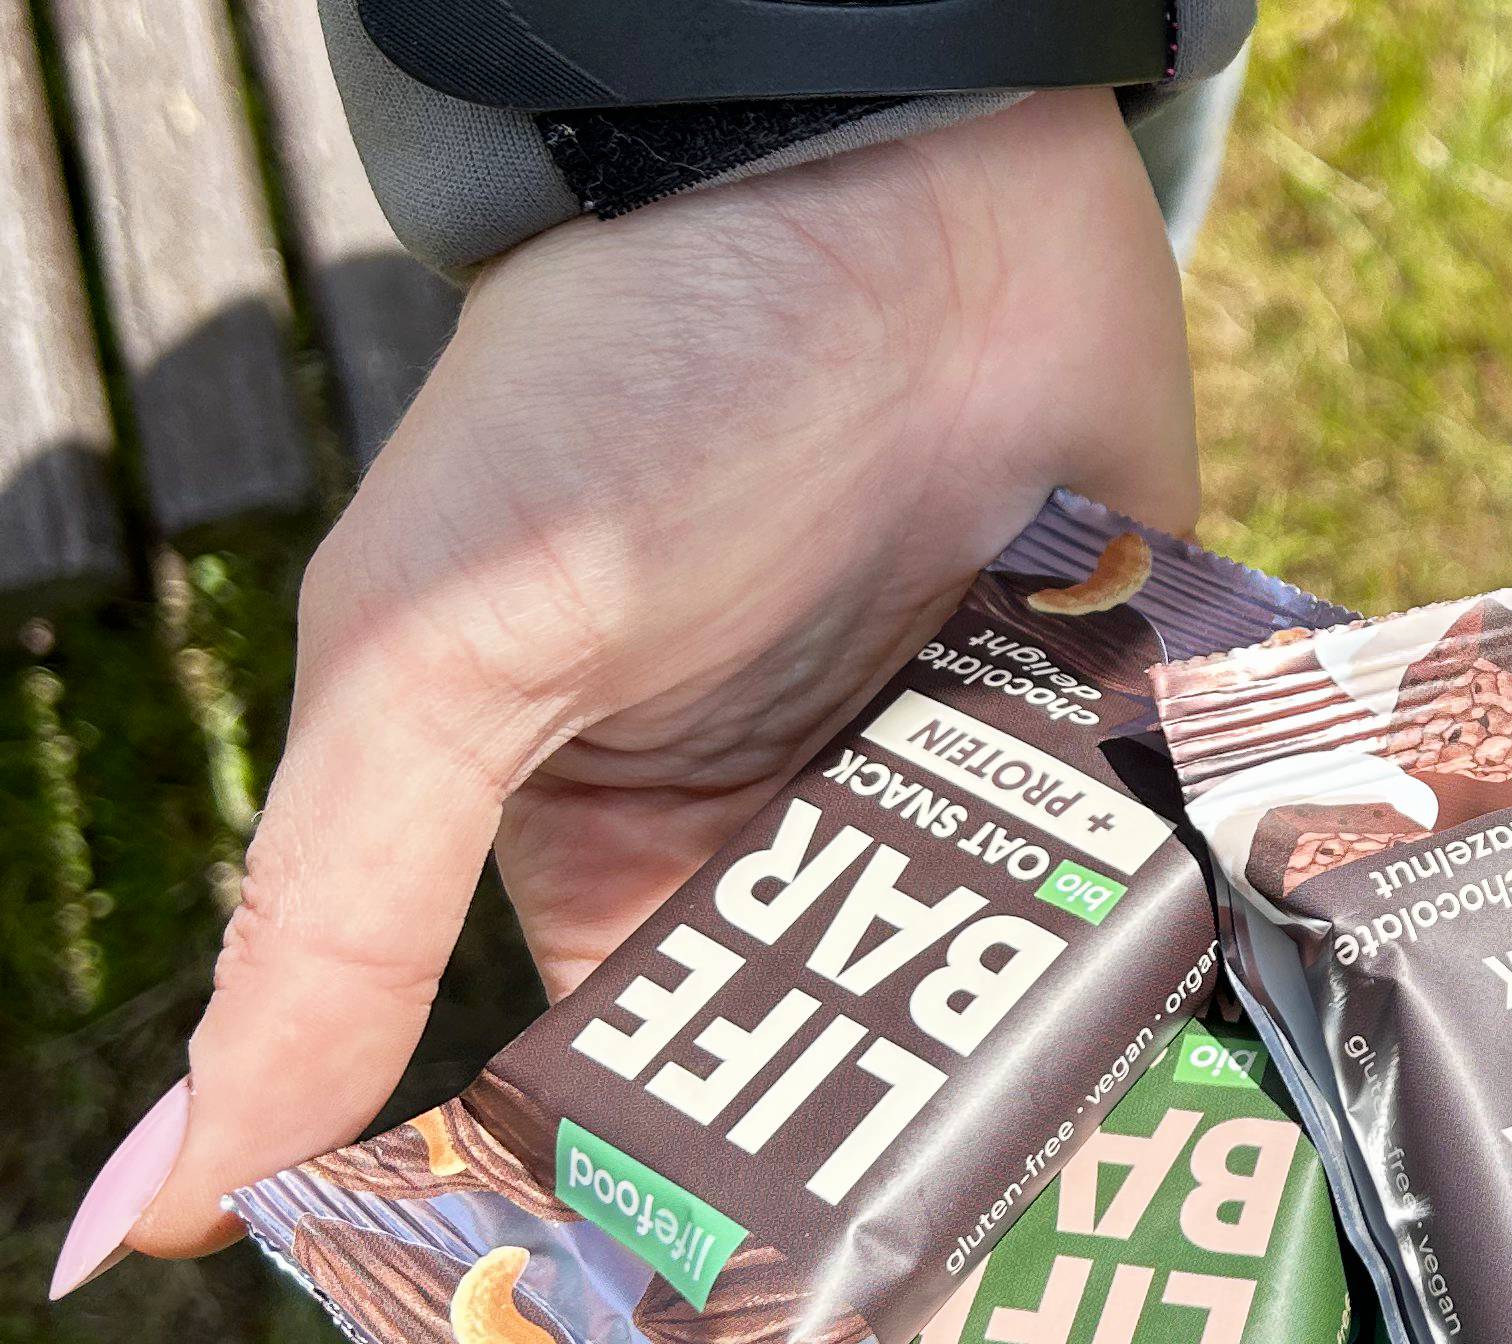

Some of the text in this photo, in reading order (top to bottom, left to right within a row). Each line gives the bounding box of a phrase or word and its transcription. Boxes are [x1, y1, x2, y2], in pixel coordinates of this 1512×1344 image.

[918, 641, 1101, 728] chocolate
[969, 628, 1104, 702] delight
[823, 747, 1121, 913] bio OAT SNACK
[907, 717, 1088, 818] PROTEIN
[713, 797, 1069, 1057] BAR
[571, 923, 950, 1206] LIFE
[1189, 1043, 1257, 1080] bio
[567, 1146, 706, 1283] lifefood
[944, 1119, 1083, 1276] gluten-free
[1084, 1035, 1158, 1111] vegan
[1056, 1106, 1303, 1258] BA
[1418, 1234, 1461, 1336] vegan
